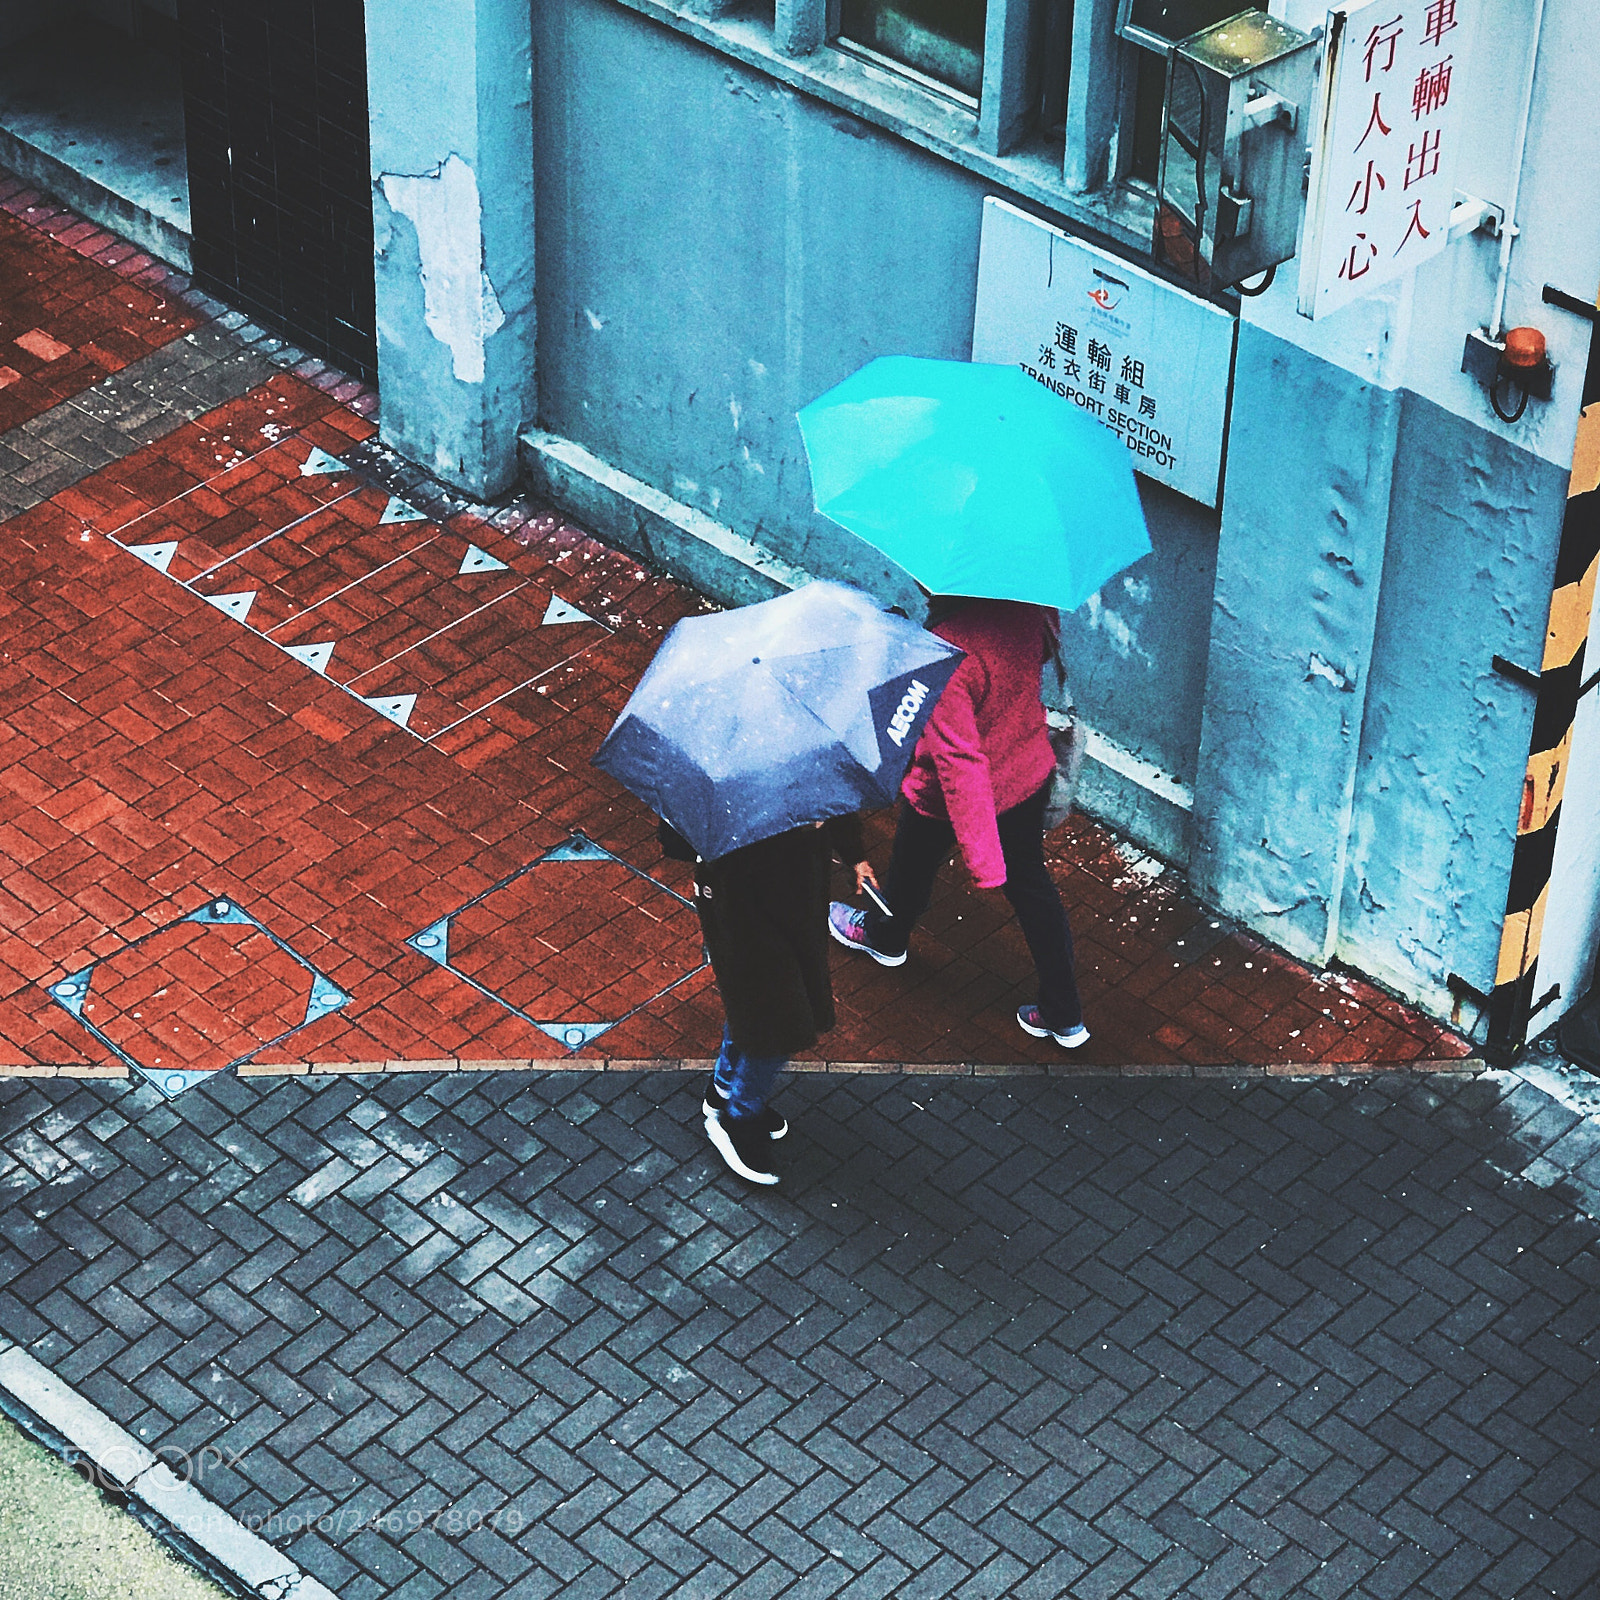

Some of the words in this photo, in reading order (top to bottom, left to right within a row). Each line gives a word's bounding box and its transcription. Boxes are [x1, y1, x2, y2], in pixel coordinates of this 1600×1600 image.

[1338, 14, 1404, 281] 行人小心
[1393, 0, 1458, 258] 車輛出入
[1038, 344, 1157, 420] 洗衣街車房
[1054, 321, 1145, 389] 運輸組
[1019, 362, 1105, 416] TRANSPORT
[1107, 407, 1172, 451] SECTION
[1126, 434, 1177, 470] DEPOT
[886, 679, 930, 747] AECOM
